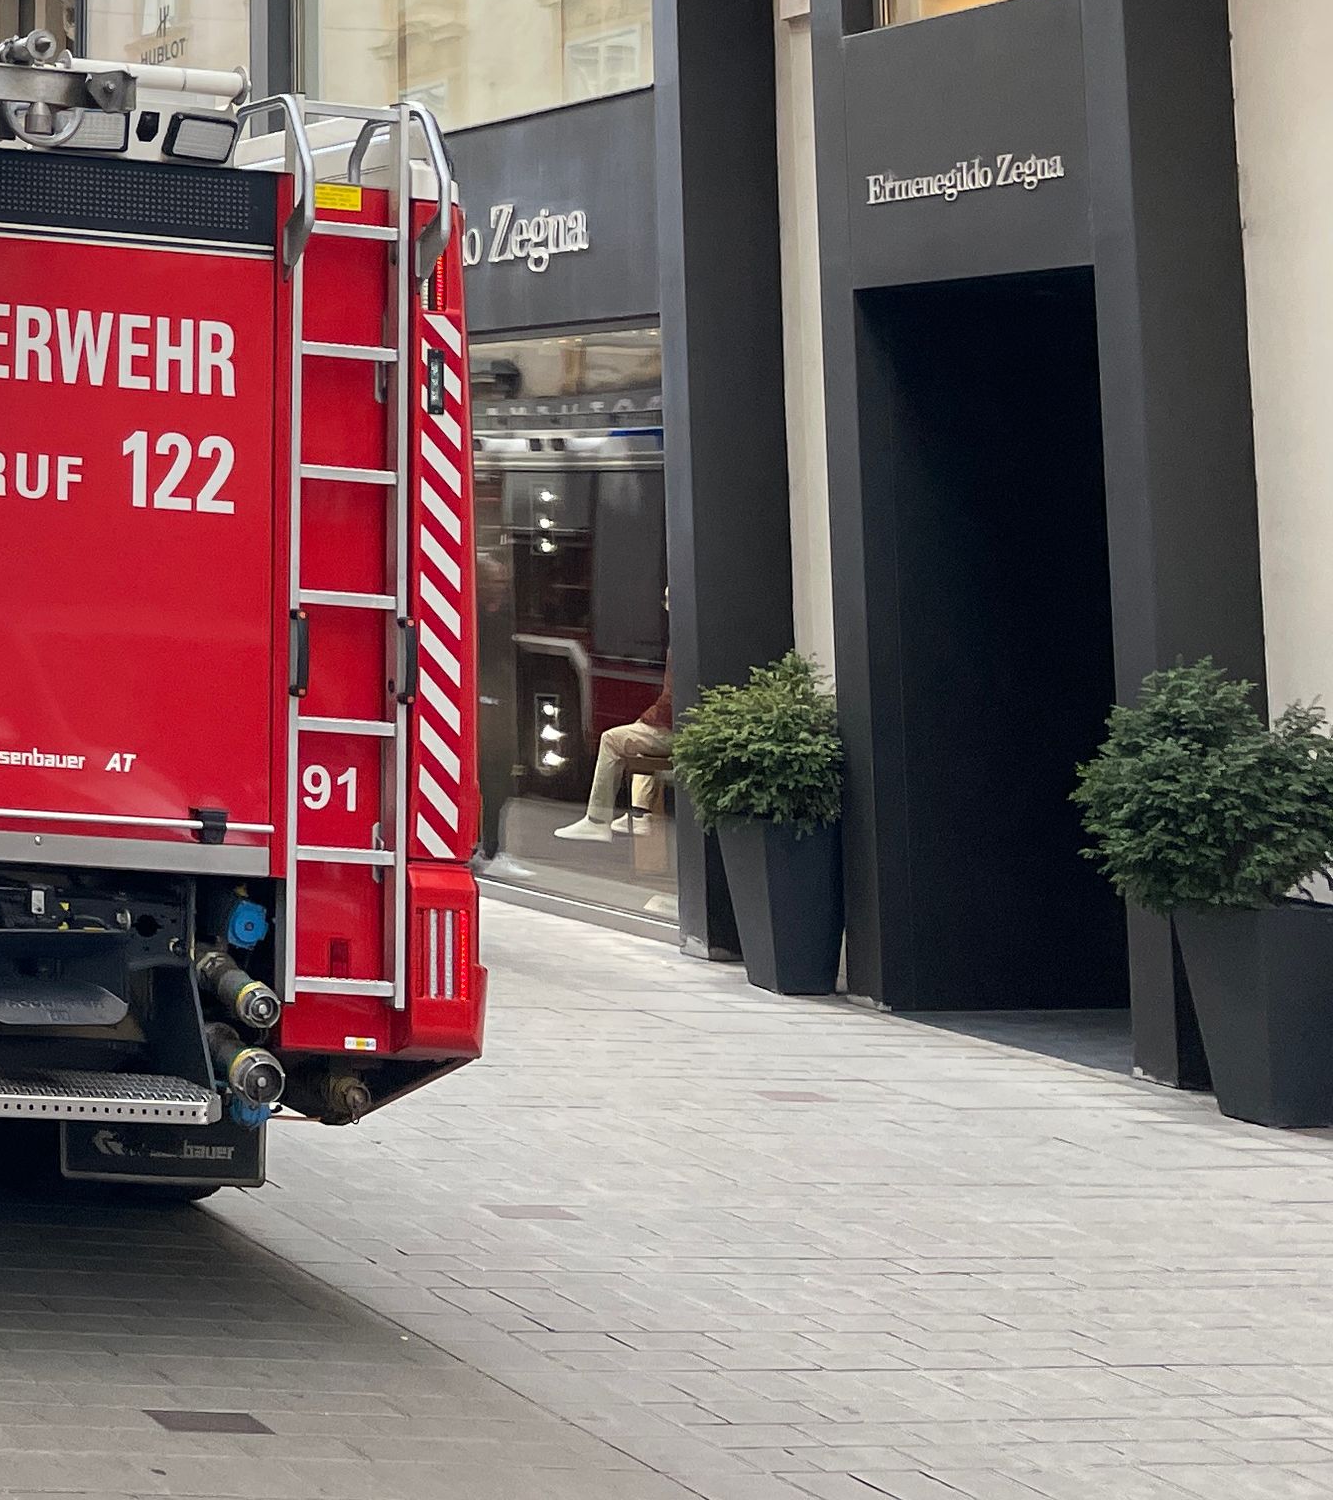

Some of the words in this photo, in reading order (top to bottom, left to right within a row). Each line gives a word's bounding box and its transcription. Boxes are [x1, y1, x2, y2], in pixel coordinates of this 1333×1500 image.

[140, 37, 186, 66] HUBLOT
[866, 159, 993, 204] Ermenegildo
[996, 153, 1065, 190] Zegna
[488, 203, 590, 273] Zegna
[121, 430, 236, 515] 122
[104, 753, 137, 773] AT
[301, 763, 359, 812] 91
